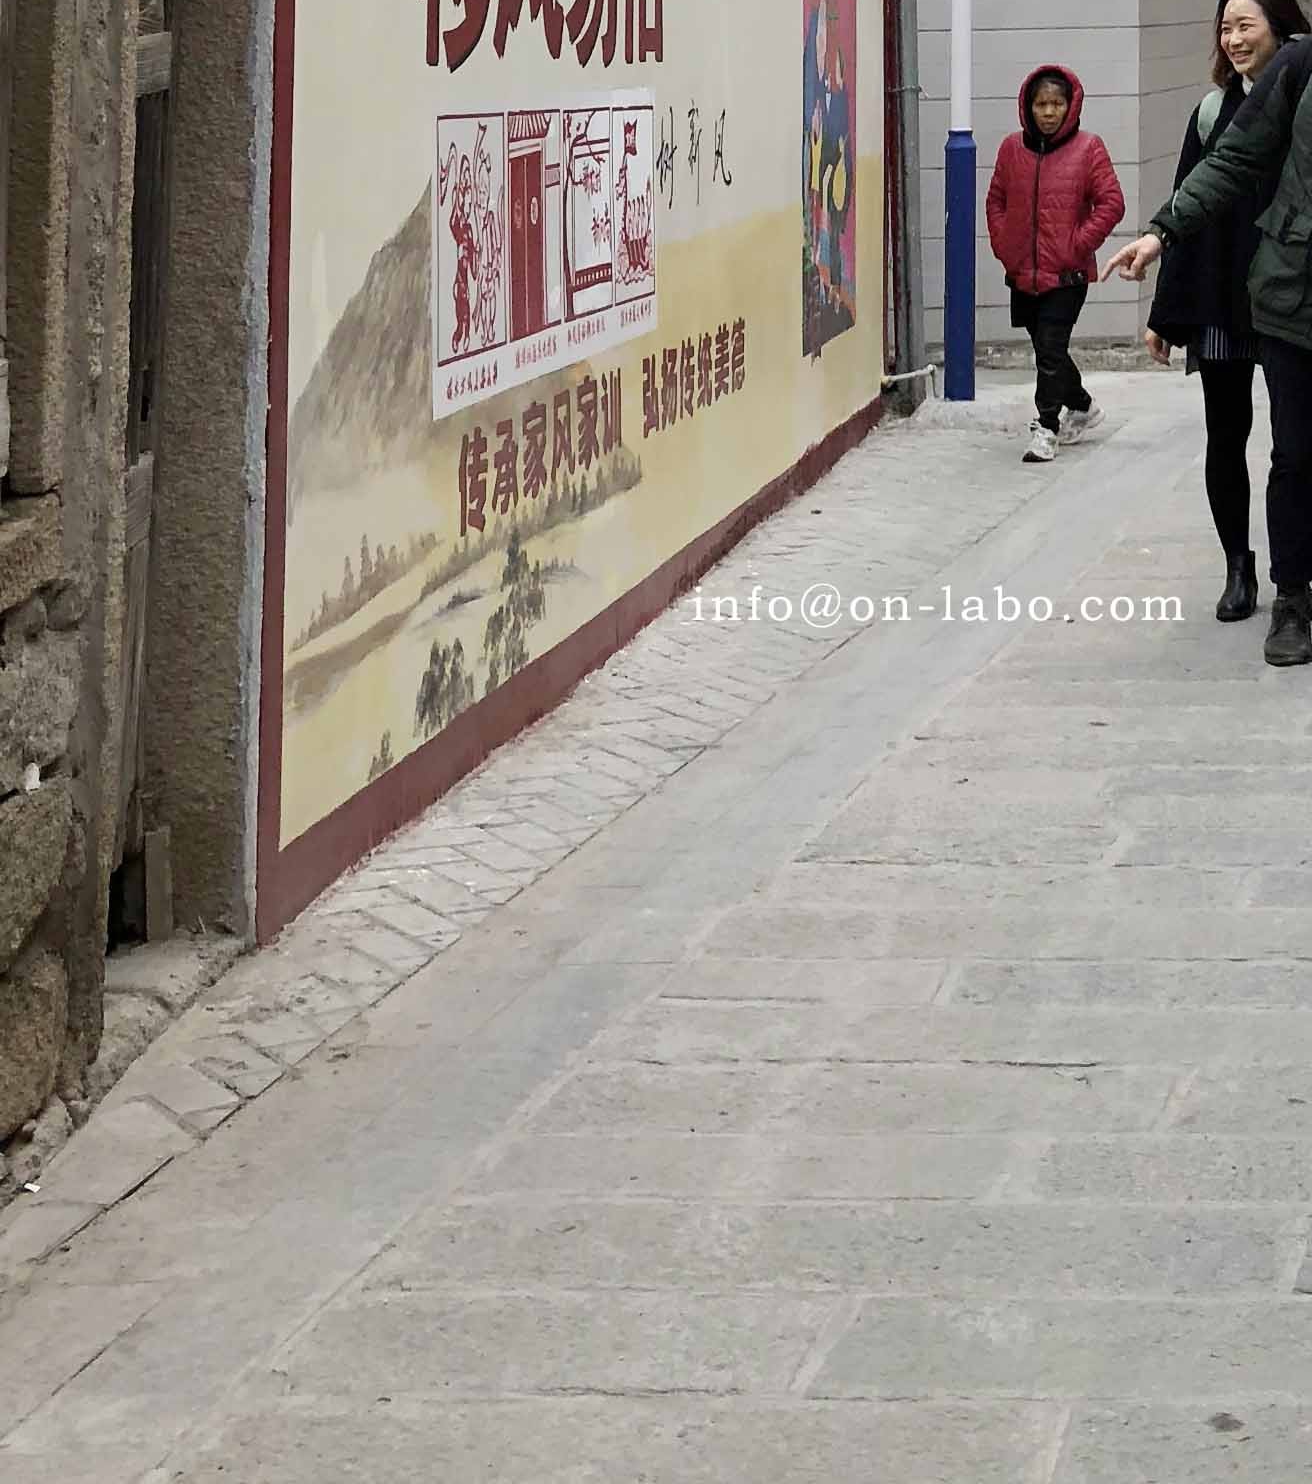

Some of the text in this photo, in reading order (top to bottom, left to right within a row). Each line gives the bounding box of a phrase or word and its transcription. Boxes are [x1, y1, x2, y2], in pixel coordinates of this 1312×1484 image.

[655, 98, 733, 210] 树新风
[457, 315, 747, 538] 传承家风家训 弘扬传统美德
